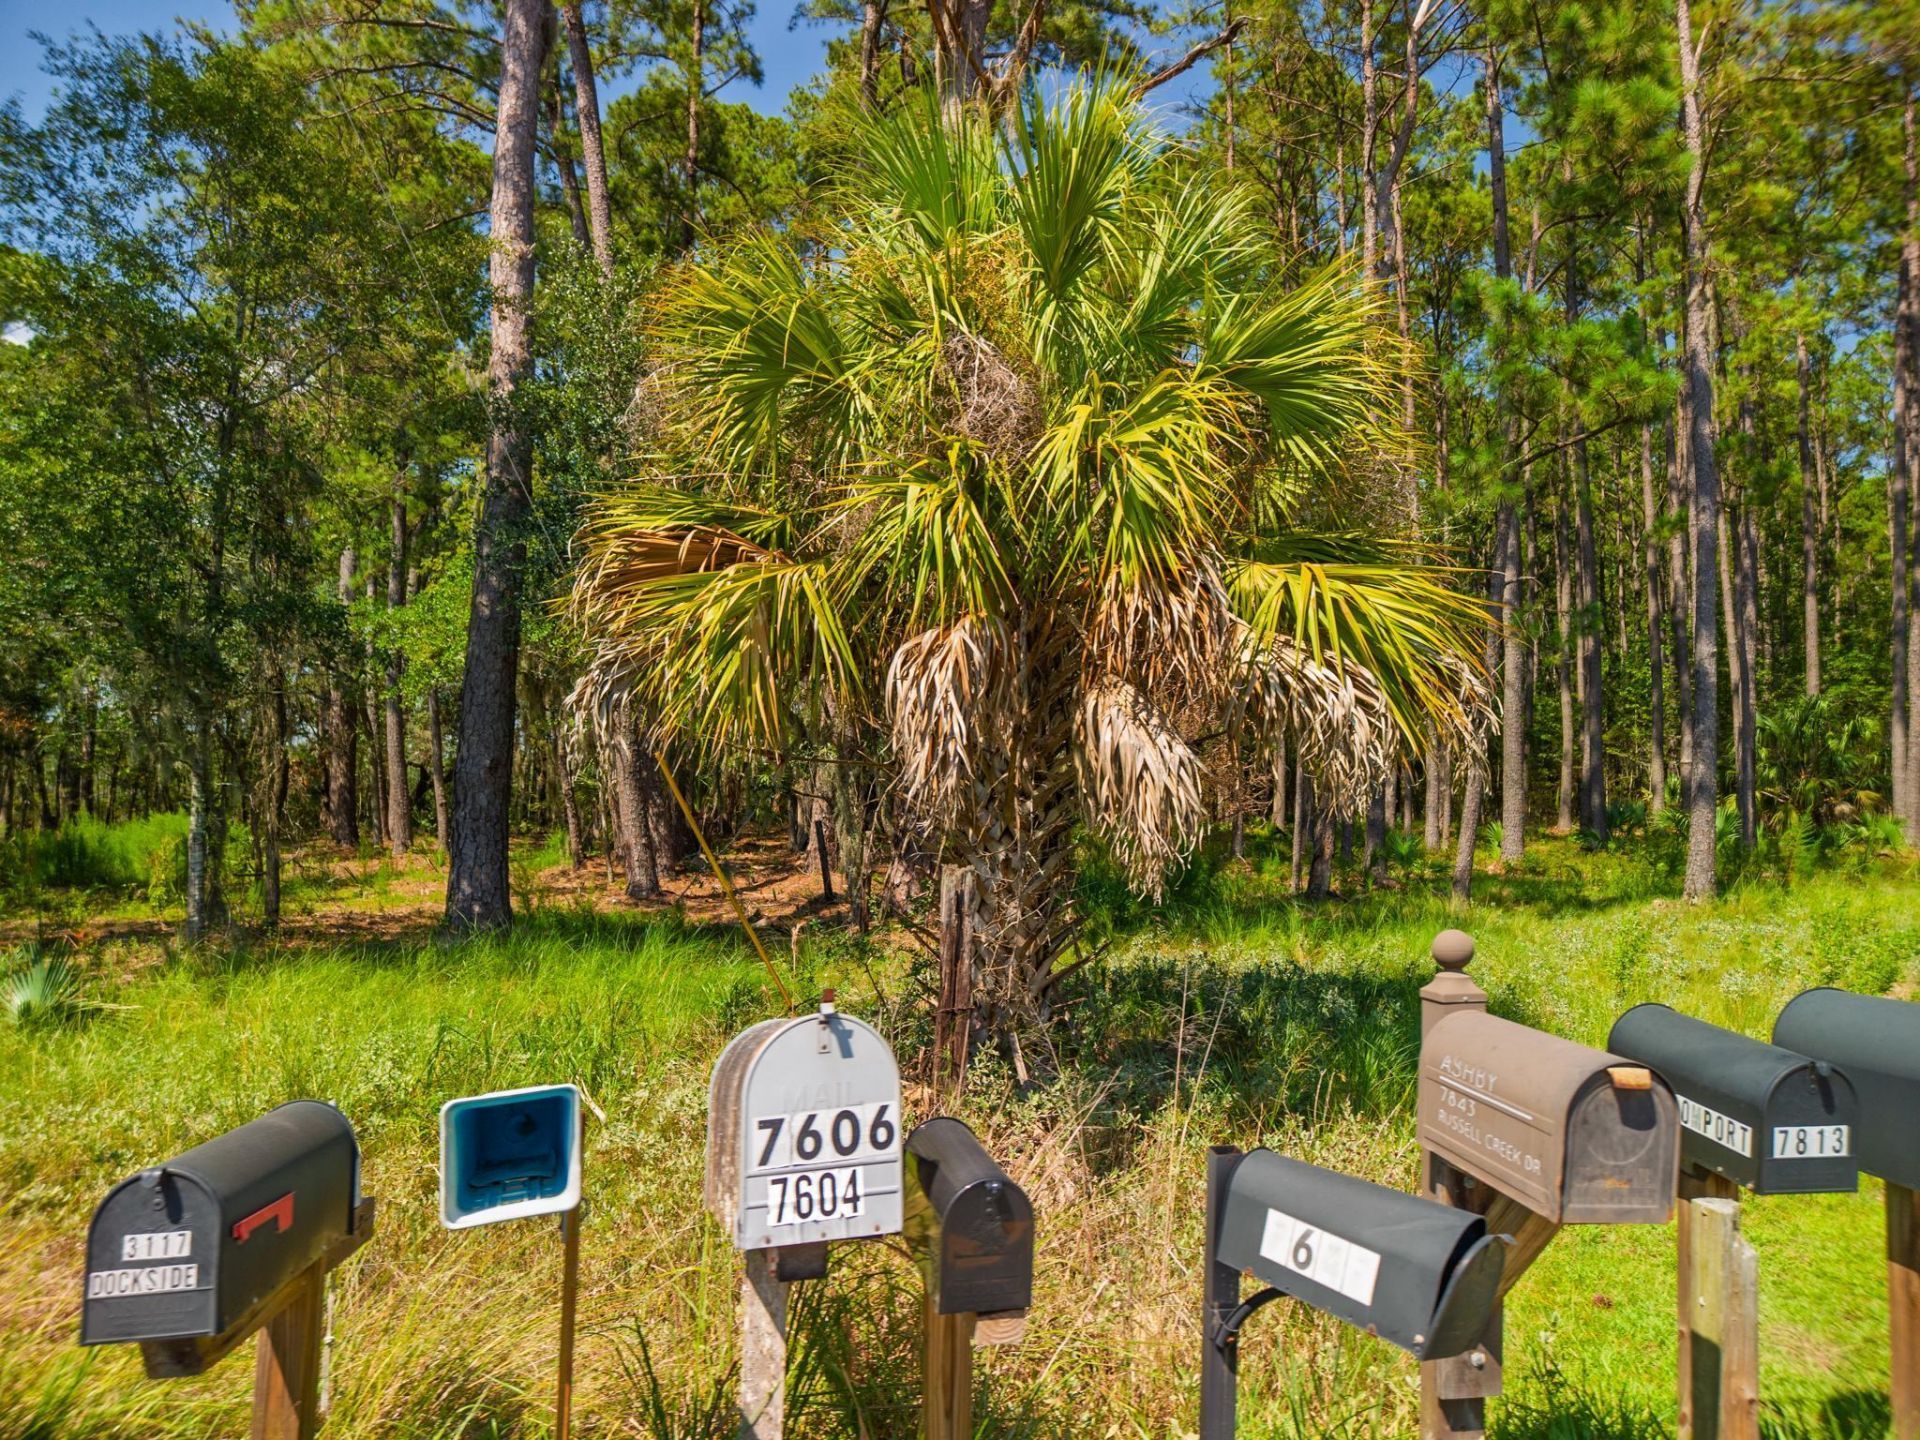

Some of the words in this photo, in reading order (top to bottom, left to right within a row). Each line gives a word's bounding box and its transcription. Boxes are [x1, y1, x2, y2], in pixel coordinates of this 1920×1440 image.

[1440, 1055, 1498, 1092] ASHBY
[779, 1080, 863, 1113] MAIL
[758, 1104, 895, 1167] 7606
[1438, 1109, 1482, 1145] RUSSELL
[1485, 1134, 1522, 1165] CREEK
[1524, 1154, 1542, 1176] DR
[1777, 1126, 1845, 1155] 7813
[771, 1169, 861, 1223] 7604
[127, 1233, 186, 1258] 3117
[1292, 1227, 1316, 1271] 6
[91, 1266, 194, 1296] DOCKSIDE
